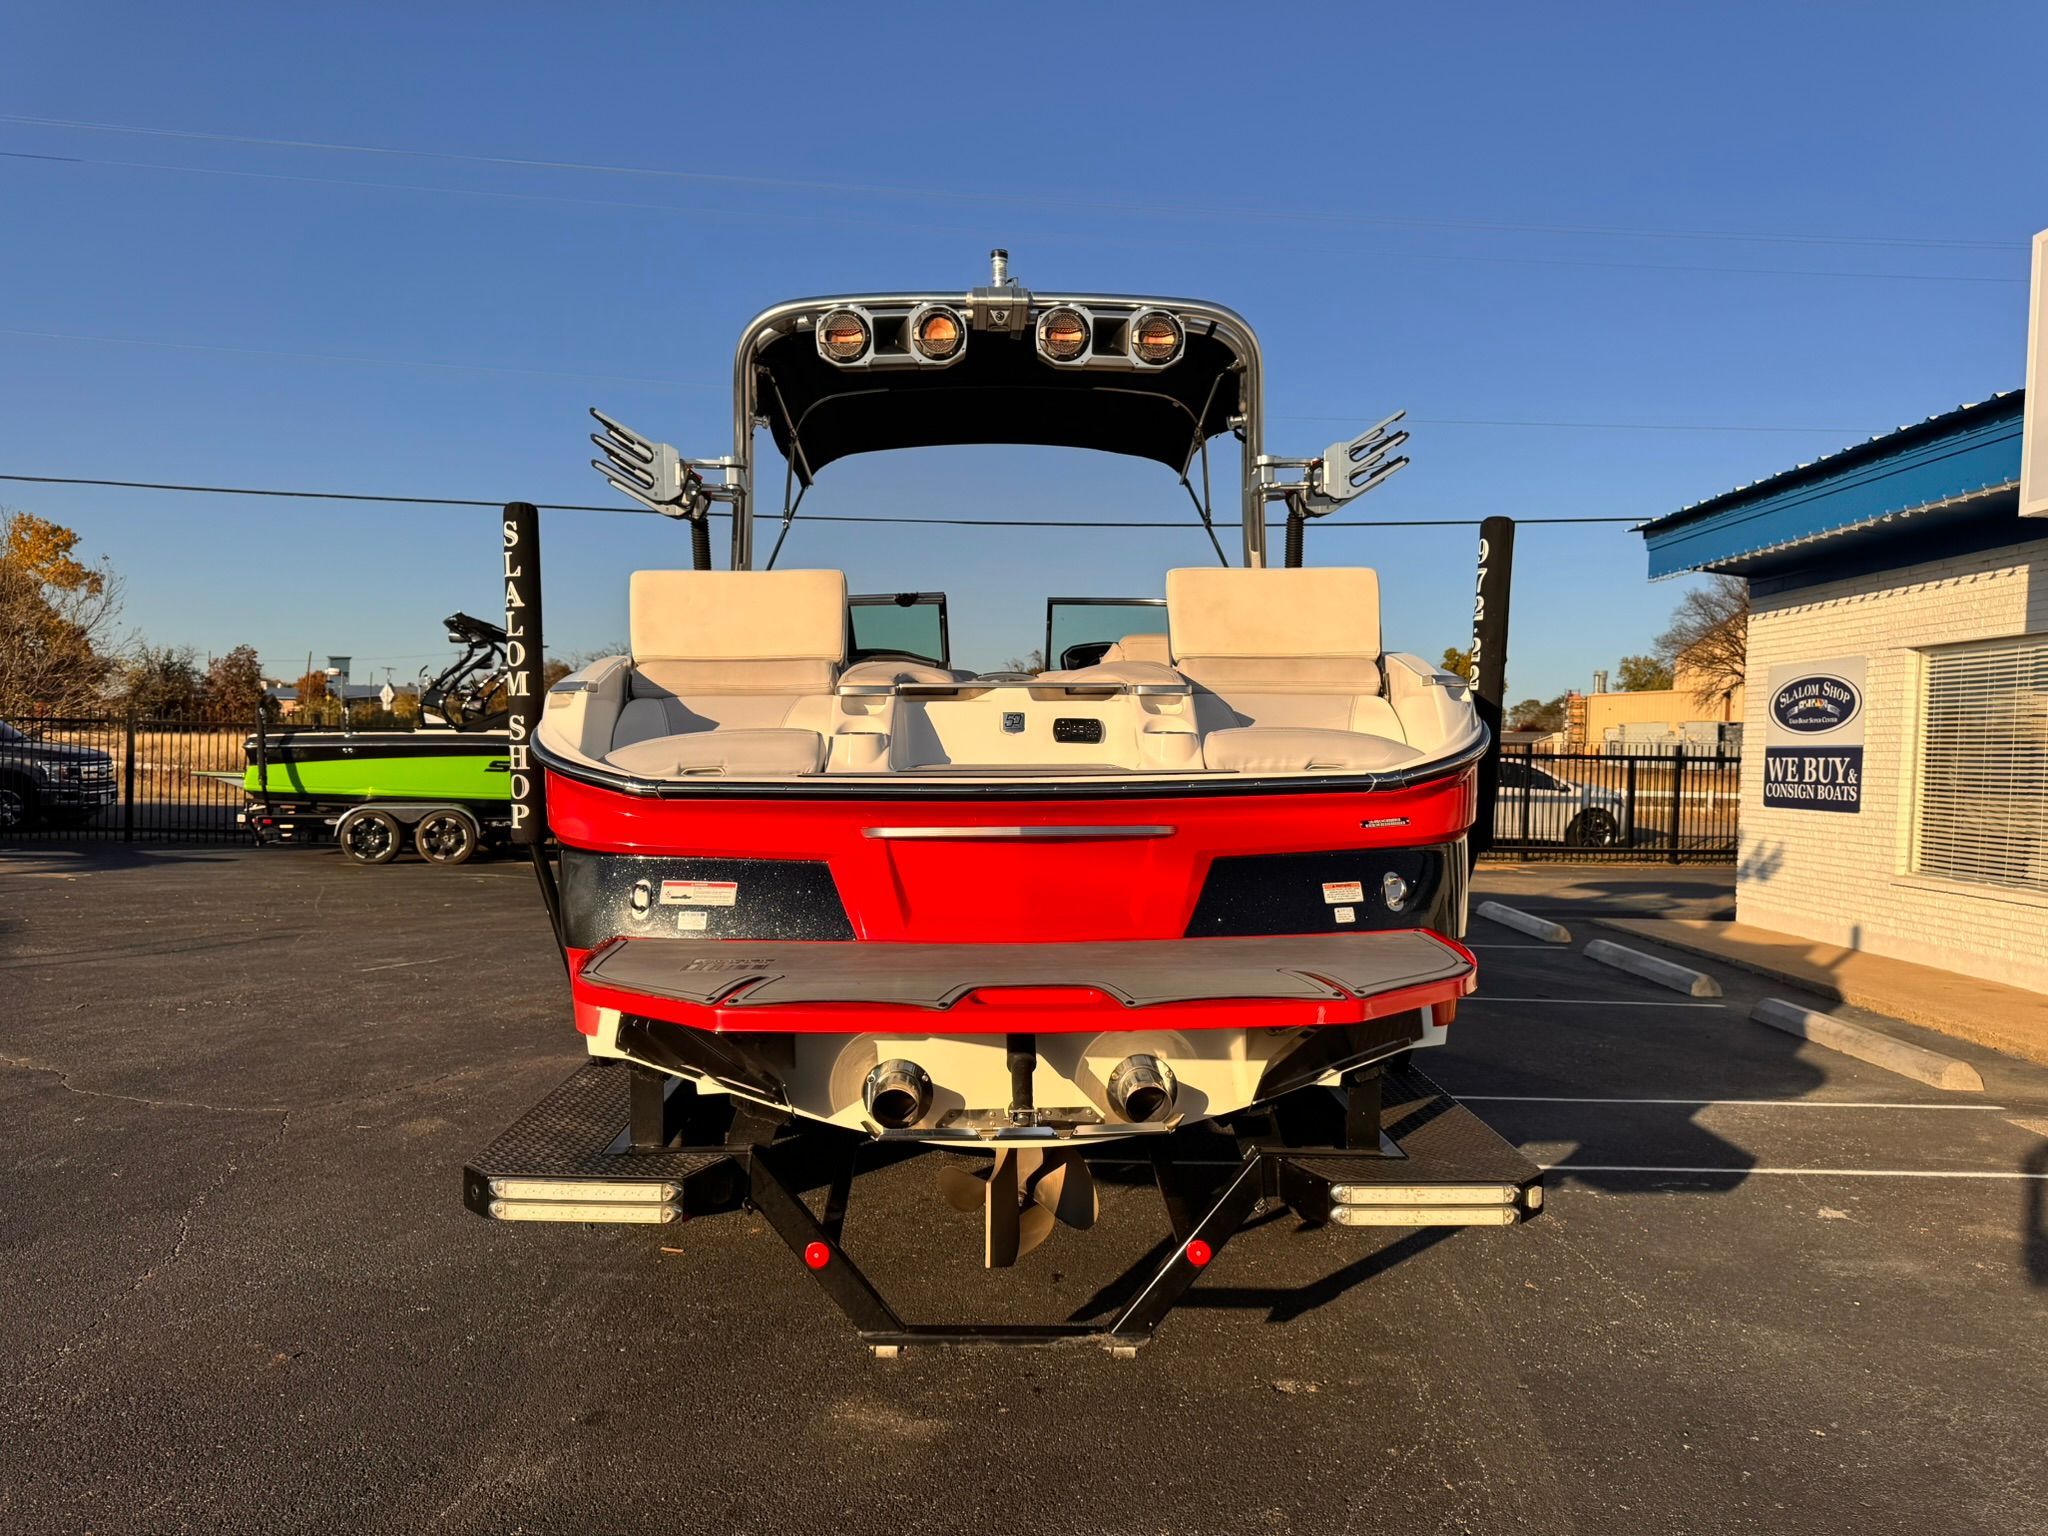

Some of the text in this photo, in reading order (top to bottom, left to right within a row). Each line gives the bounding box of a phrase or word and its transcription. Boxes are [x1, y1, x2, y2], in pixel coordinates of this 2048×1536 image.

[503, 520, 531, 829] SLALOM SHOP
[1779, 681, 1850, 708] SLALOM SHOP
[1767, 757, 1858, 784] WE BUY &
[1766, 782, 1857, 802] CONSIGN BOATS
